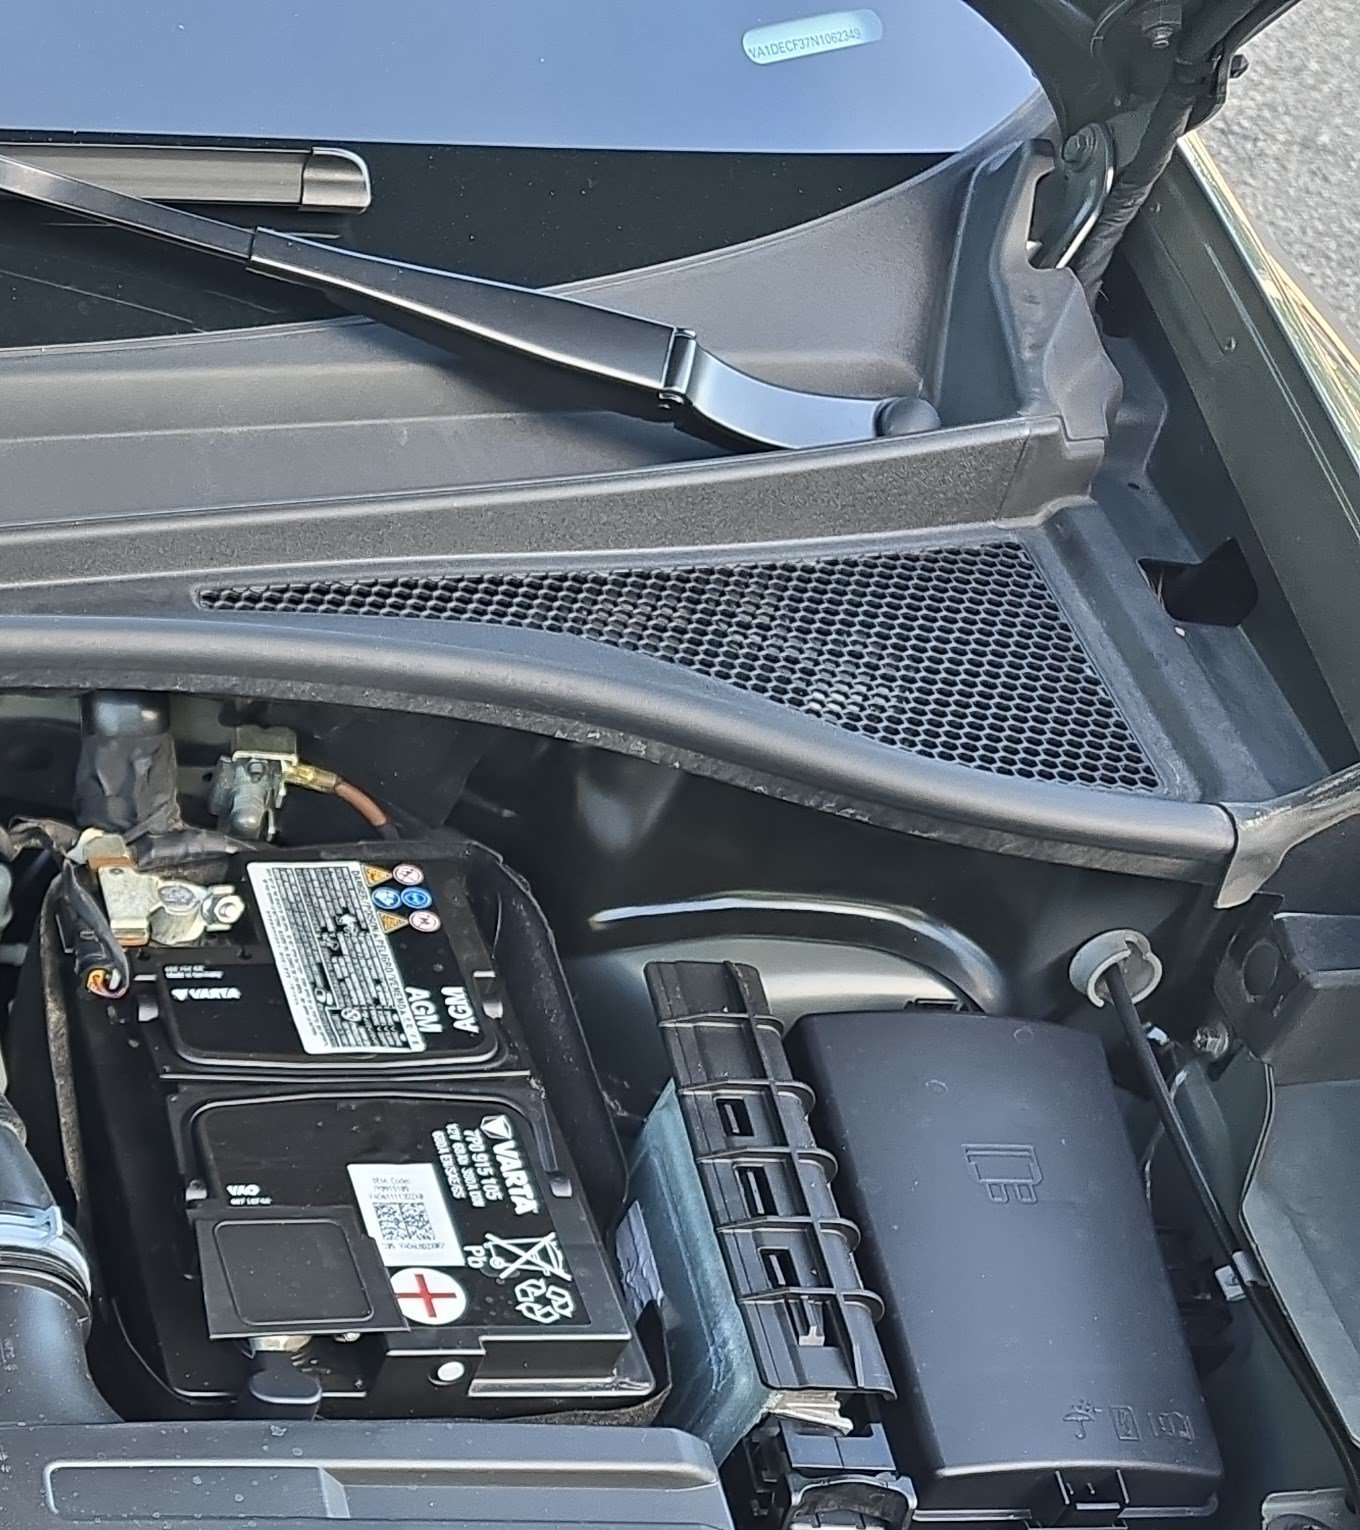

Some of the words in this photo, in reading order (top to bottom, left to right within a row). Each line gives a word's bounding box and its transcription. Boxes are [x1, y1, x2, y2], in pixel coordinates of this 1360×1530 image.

[405, 987, 443, 1033] AGM
[441, 987, 480, 1033] AGM
[463, 1129, 485, 1152] 7P0
[472, 1153, 494, 1176] 915
[481, 1178, 503, 1200] 105
[493, 1140, 539, 1215] VARTA
[463, 1245, 488, 1268] Pb
